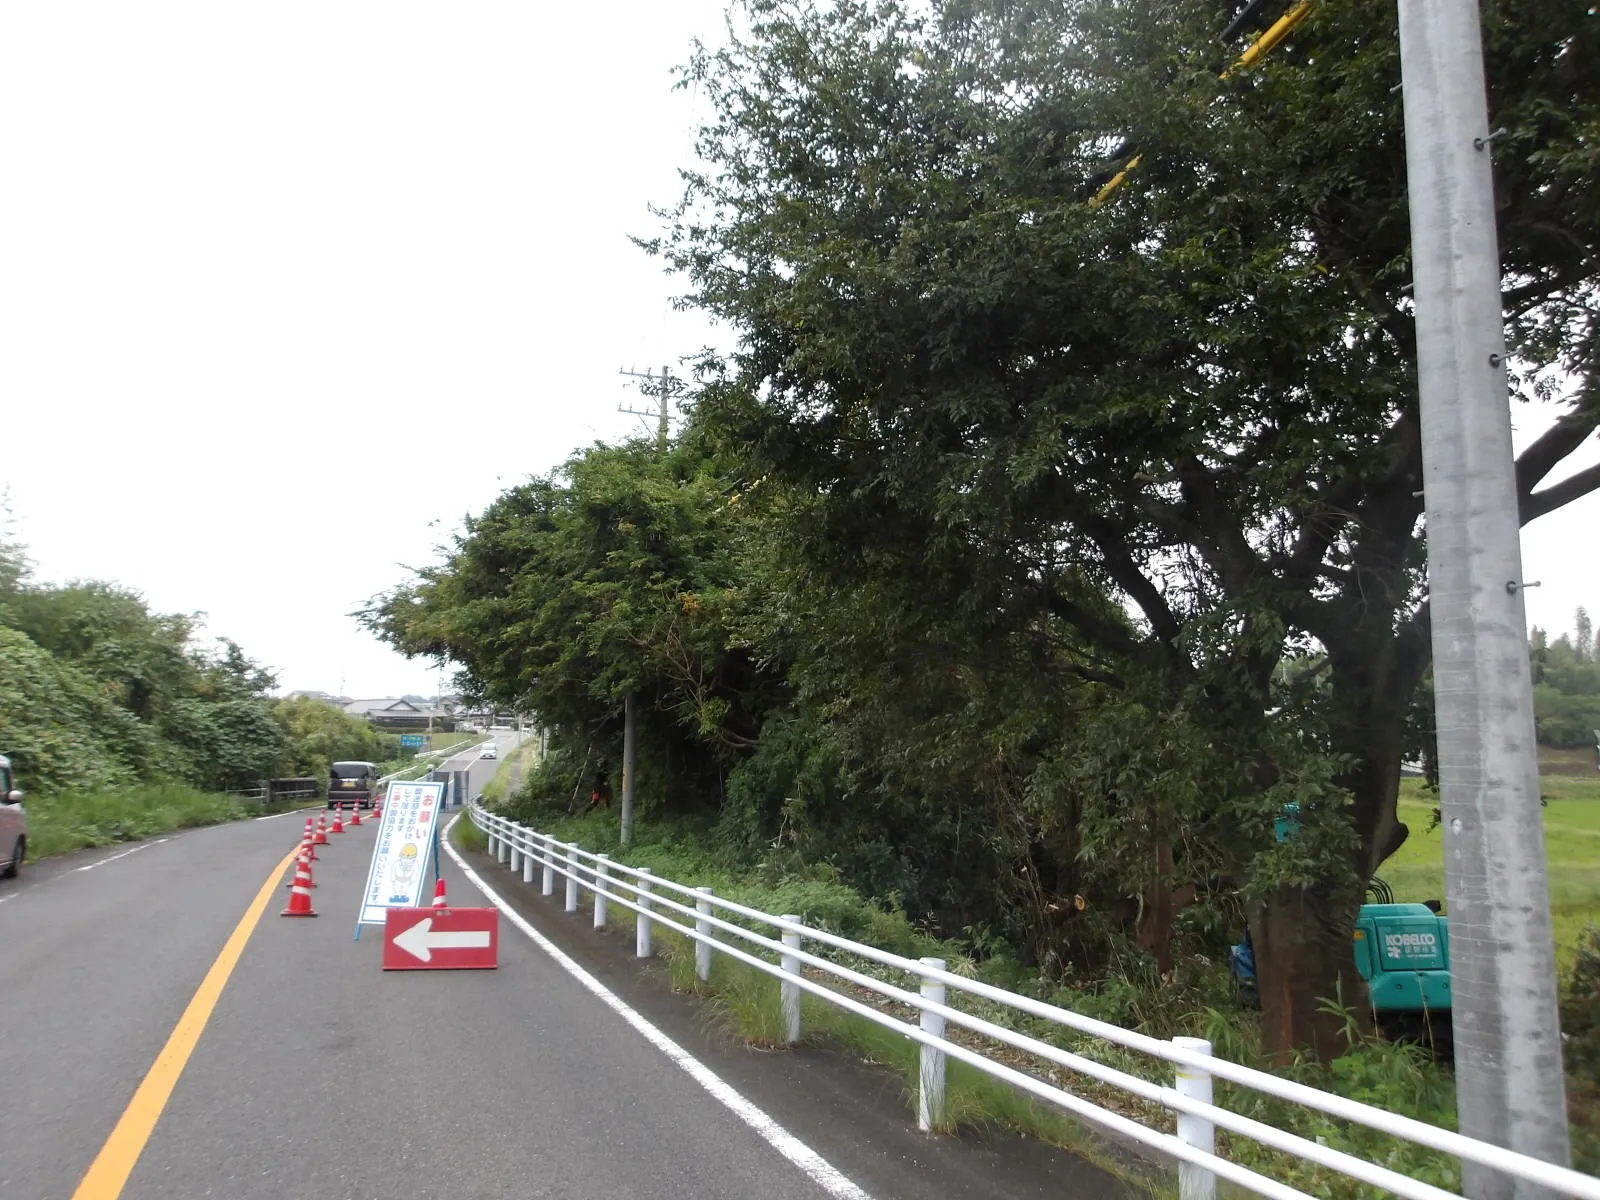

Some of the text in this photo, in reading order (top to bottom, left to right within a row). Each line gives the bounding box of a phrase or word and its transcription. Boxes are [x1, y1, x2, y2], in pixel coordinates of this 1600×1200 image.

[416, 795, 434, 840] お願い
[1385, 933, 1435, 946] KOBELCO
